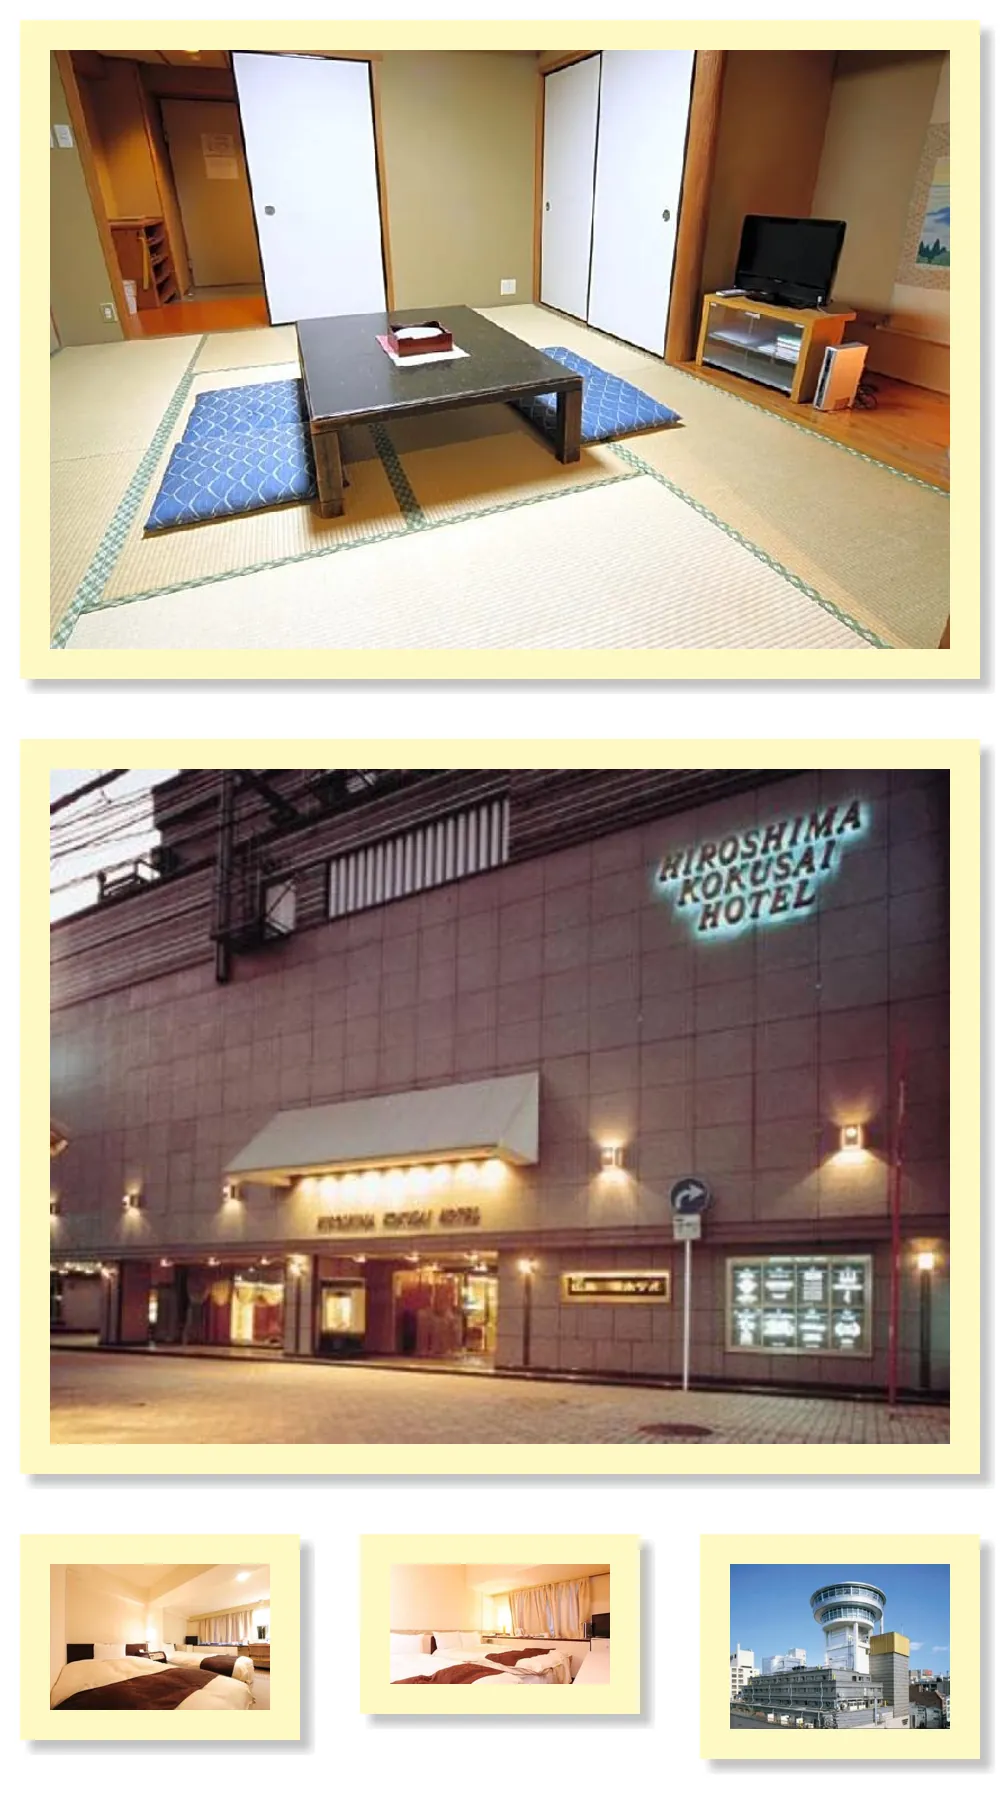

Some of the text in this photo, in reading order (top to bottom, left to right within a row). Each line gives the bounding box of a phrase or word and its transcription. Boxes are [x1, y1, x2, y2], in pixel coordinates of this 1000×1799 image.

[660, 800, 862, 882] HIROSHIMA
[677, 839, 836, 907] KOKUSAI
[698, 878, 816, 931] HOTEL
